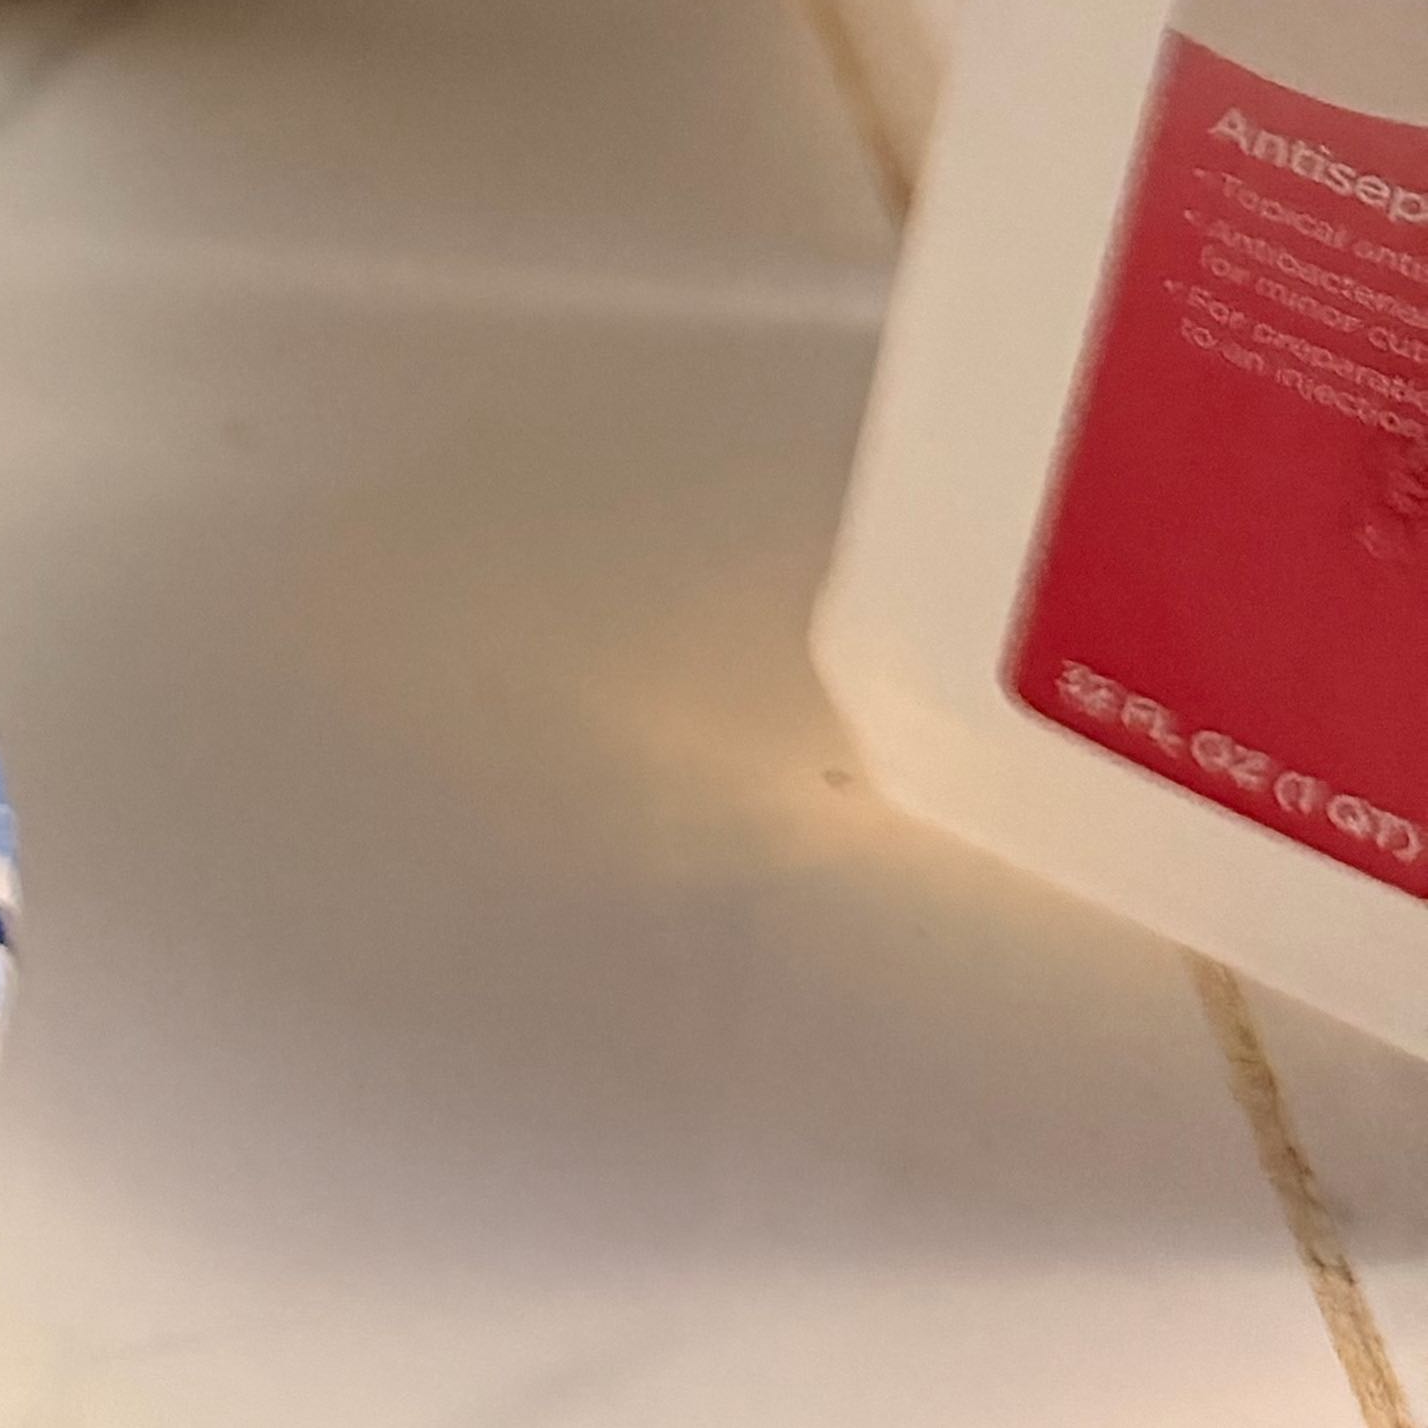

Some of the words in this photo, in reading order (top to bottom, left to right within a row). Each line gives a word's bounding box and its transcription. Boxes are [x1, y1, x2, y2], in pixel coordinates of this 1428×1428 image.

[1222, 172, 1349, 248] Topical
[1188, 286, 1245, 329] For
[1202, 246, 1248, 283] for
[1256, 277, 1364, 333] minor
[1182, 317, 1217, 348] to
